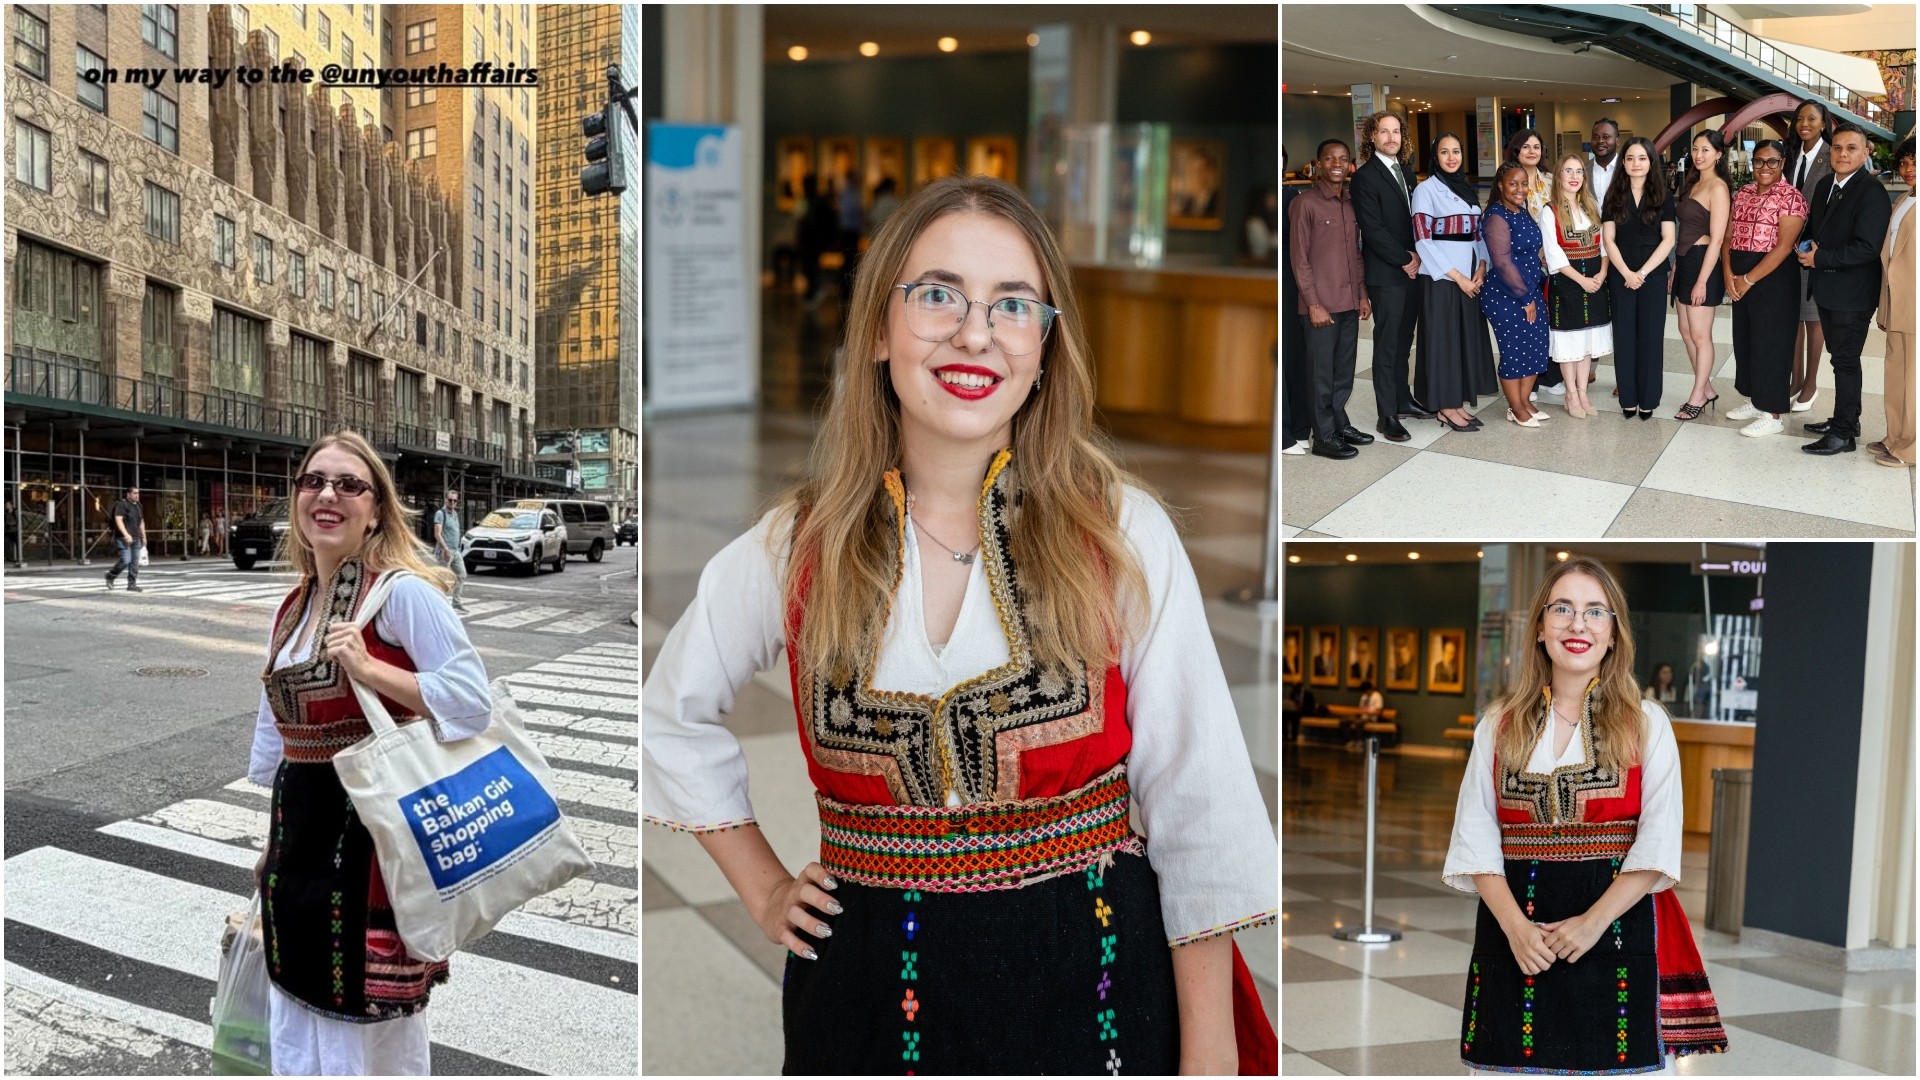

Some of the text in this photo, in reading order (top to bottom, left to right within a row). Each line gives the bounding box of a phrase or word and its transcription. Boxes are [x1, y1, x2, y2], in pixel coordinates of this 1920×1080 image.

[413, 793, 450, 818] the
[422, 775, 513, 836] Balkan Girl
[431, 799, 515, 853] shopping
[436, 840, 483, 871] bag:
